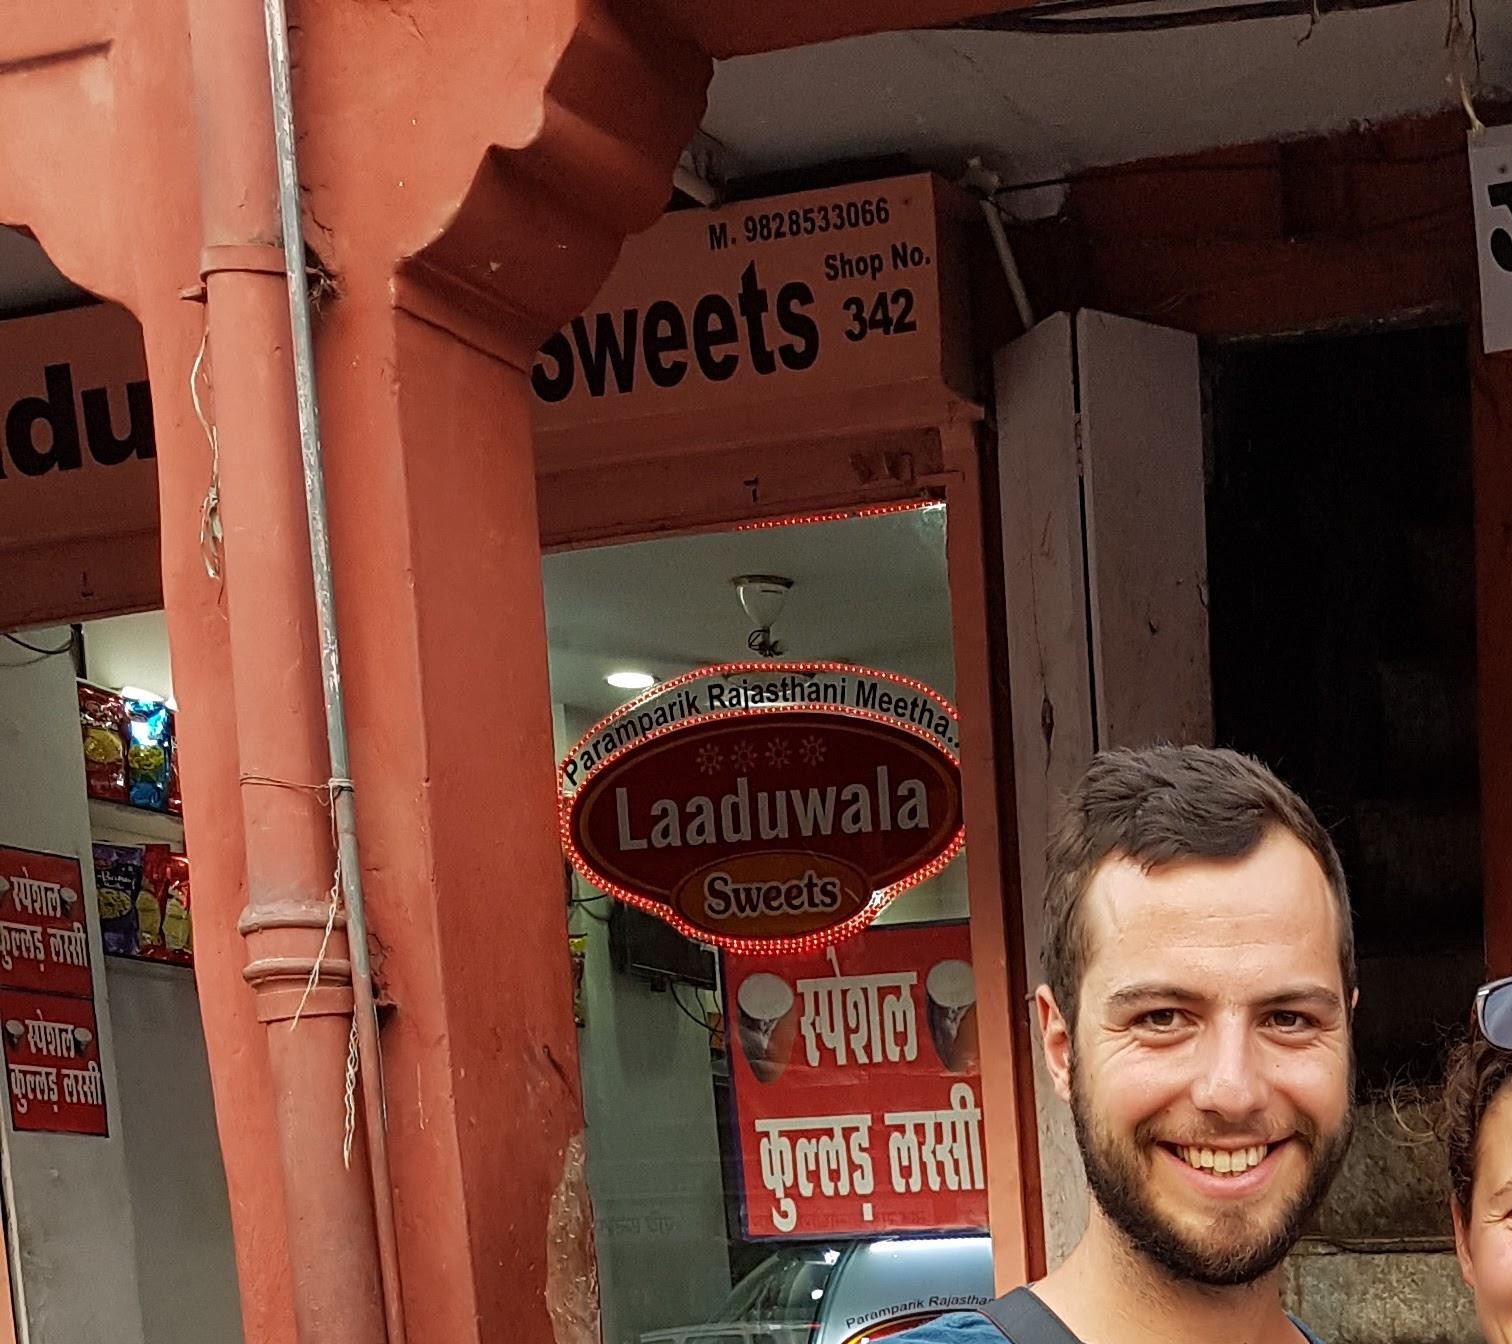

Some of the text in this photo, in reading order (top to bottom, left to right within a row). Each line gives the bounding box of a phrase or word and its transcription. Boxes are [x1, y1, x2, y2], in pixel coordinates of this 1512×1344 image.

[708, 198, 890, 251] M. 9828533066
[824, 242, 932, 281] Shop No.
[842, 288, 917, 342] 342
[0, 363, 156, 479] du
[563, 690, 701, 786] Paramparik
[707, 676, 846, 712] Rajasthani
[616, 765, 930, 851] Laaduwala
[706, 874, 838, 916] Sweets
[796, 945, 918, 1067] स्पेशल
[846, 1298, 925, 1329] Paramparik
